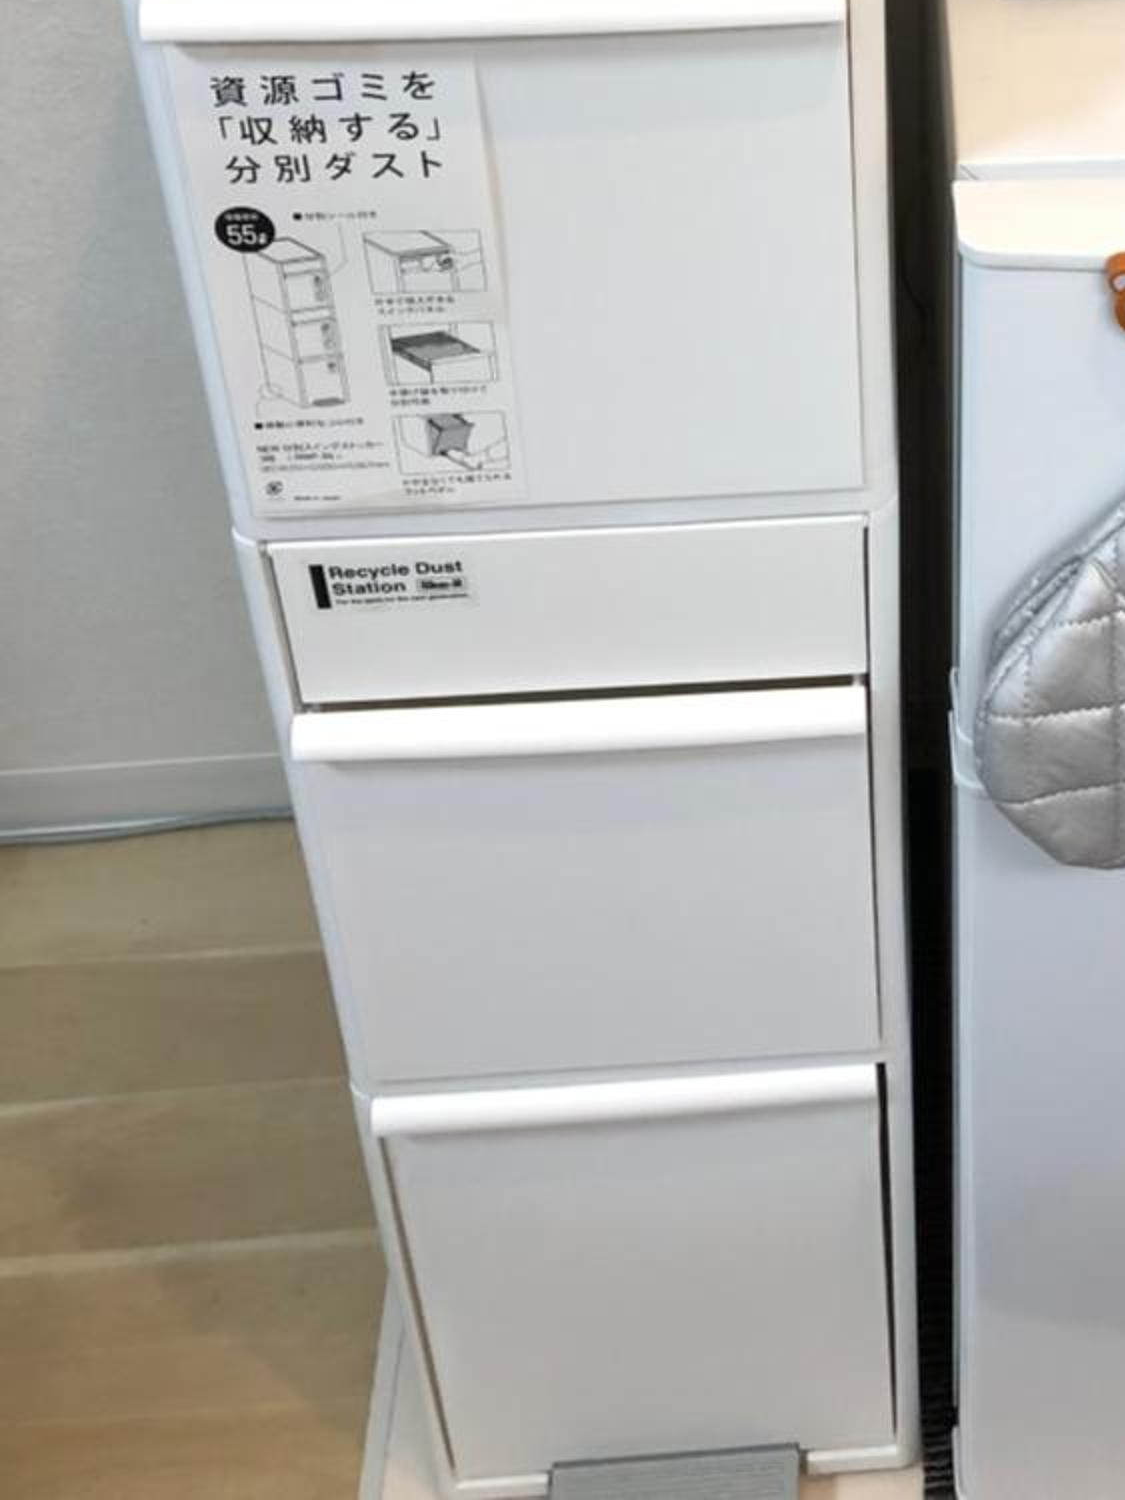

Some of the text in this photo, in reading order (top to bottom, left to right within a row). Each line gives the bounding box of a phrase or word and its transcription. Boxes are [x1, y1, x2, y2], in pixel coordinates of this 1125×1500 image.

[209, 70, 437, 108] 資源ゴミを
[218, 111, 444, 147] 「収納する」
[224, 151, 443, 184] 分別ダスト
[328, 561, 463, 581] Recycle Dust
[331, 580, 407, 596] Station
